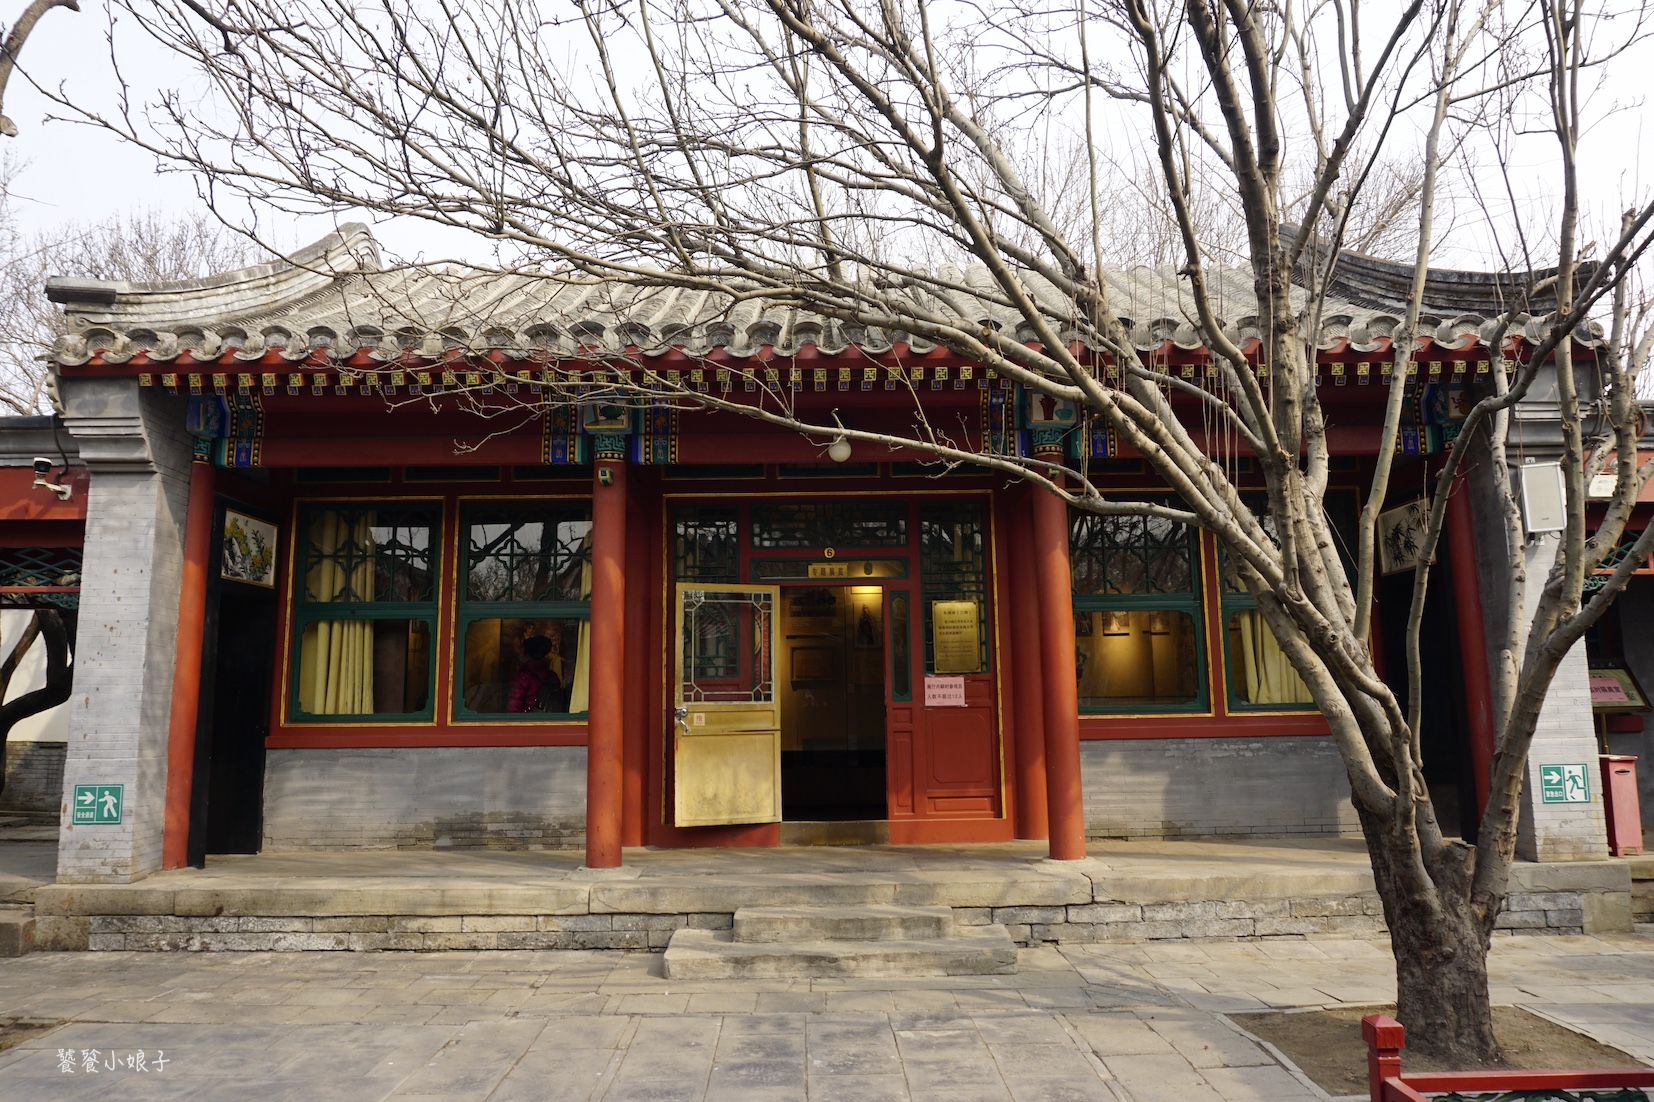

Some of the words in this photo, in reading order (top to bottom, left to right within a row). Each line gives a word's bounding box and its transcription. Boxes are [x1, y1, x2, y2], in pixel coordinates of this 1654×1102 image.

[826, 548, 833, 557] 6
[812, 567, 844, 576] 专题展览
